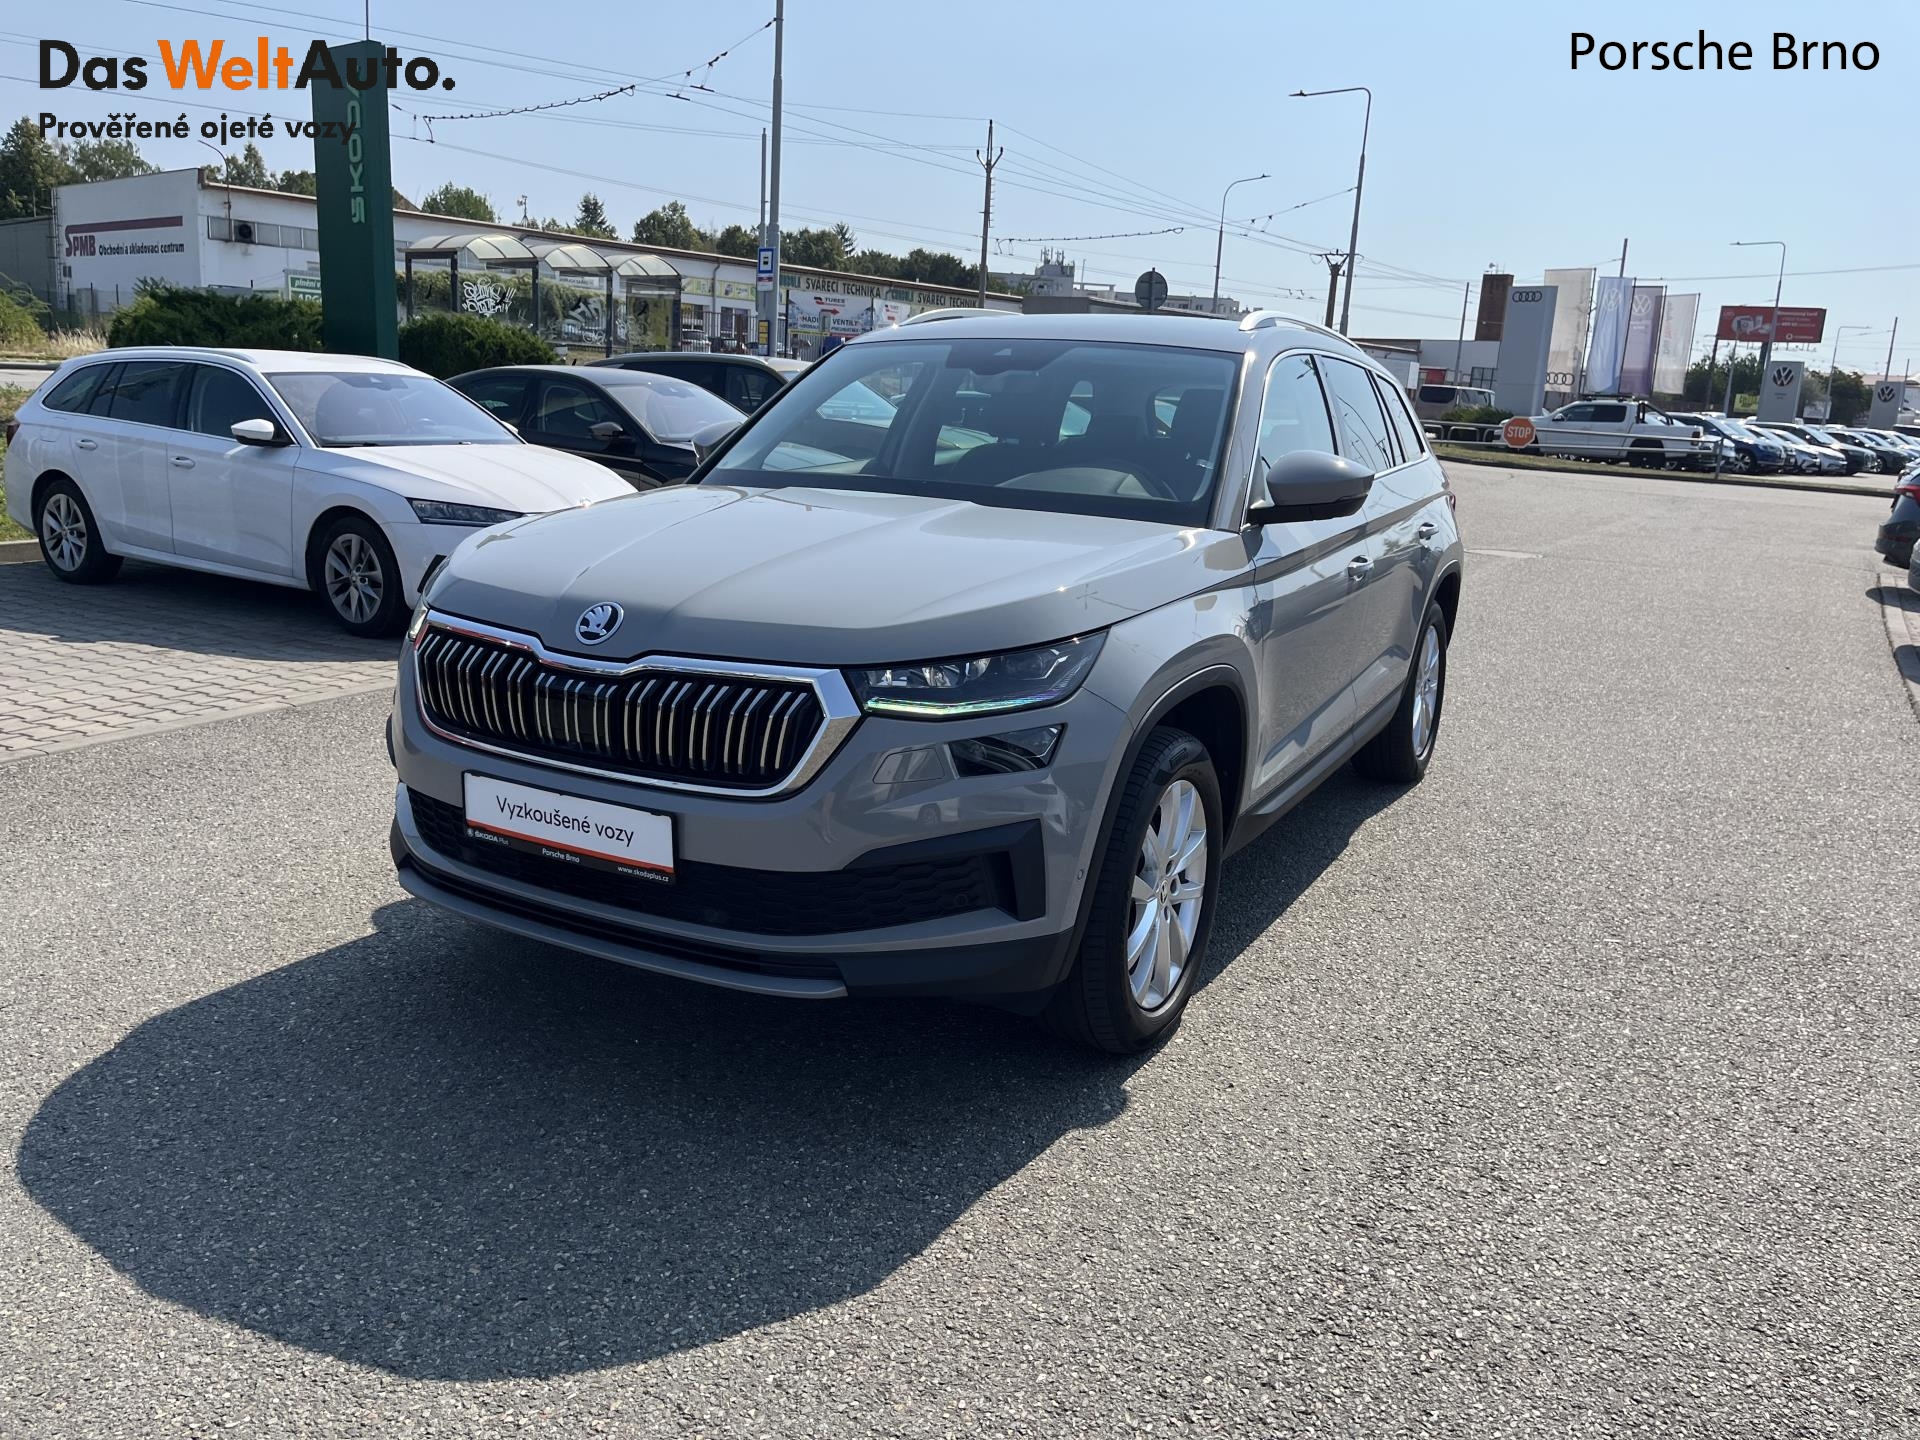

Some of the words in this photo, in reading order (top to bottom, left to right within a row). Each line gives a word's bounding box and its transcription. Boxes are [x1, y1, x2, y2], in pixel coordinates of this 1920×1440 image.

[65, 225, 96, 257] SPMB
[161, 242, 185, 253] centrum
[842, 282, 881, 298] TECHNIKA
[949, 296, 977, 308] TECHNIK
[1507, 426, 1531, 438] STOP
[496, 794, 591, 834] Vyzkoušené
[595, 823, 634, 847] vozy
[542, 847, 565, 860] Porsche
[566, 852, 580, 863] Brno
[617, 865, 670, 883] www.skodaplus.cz
